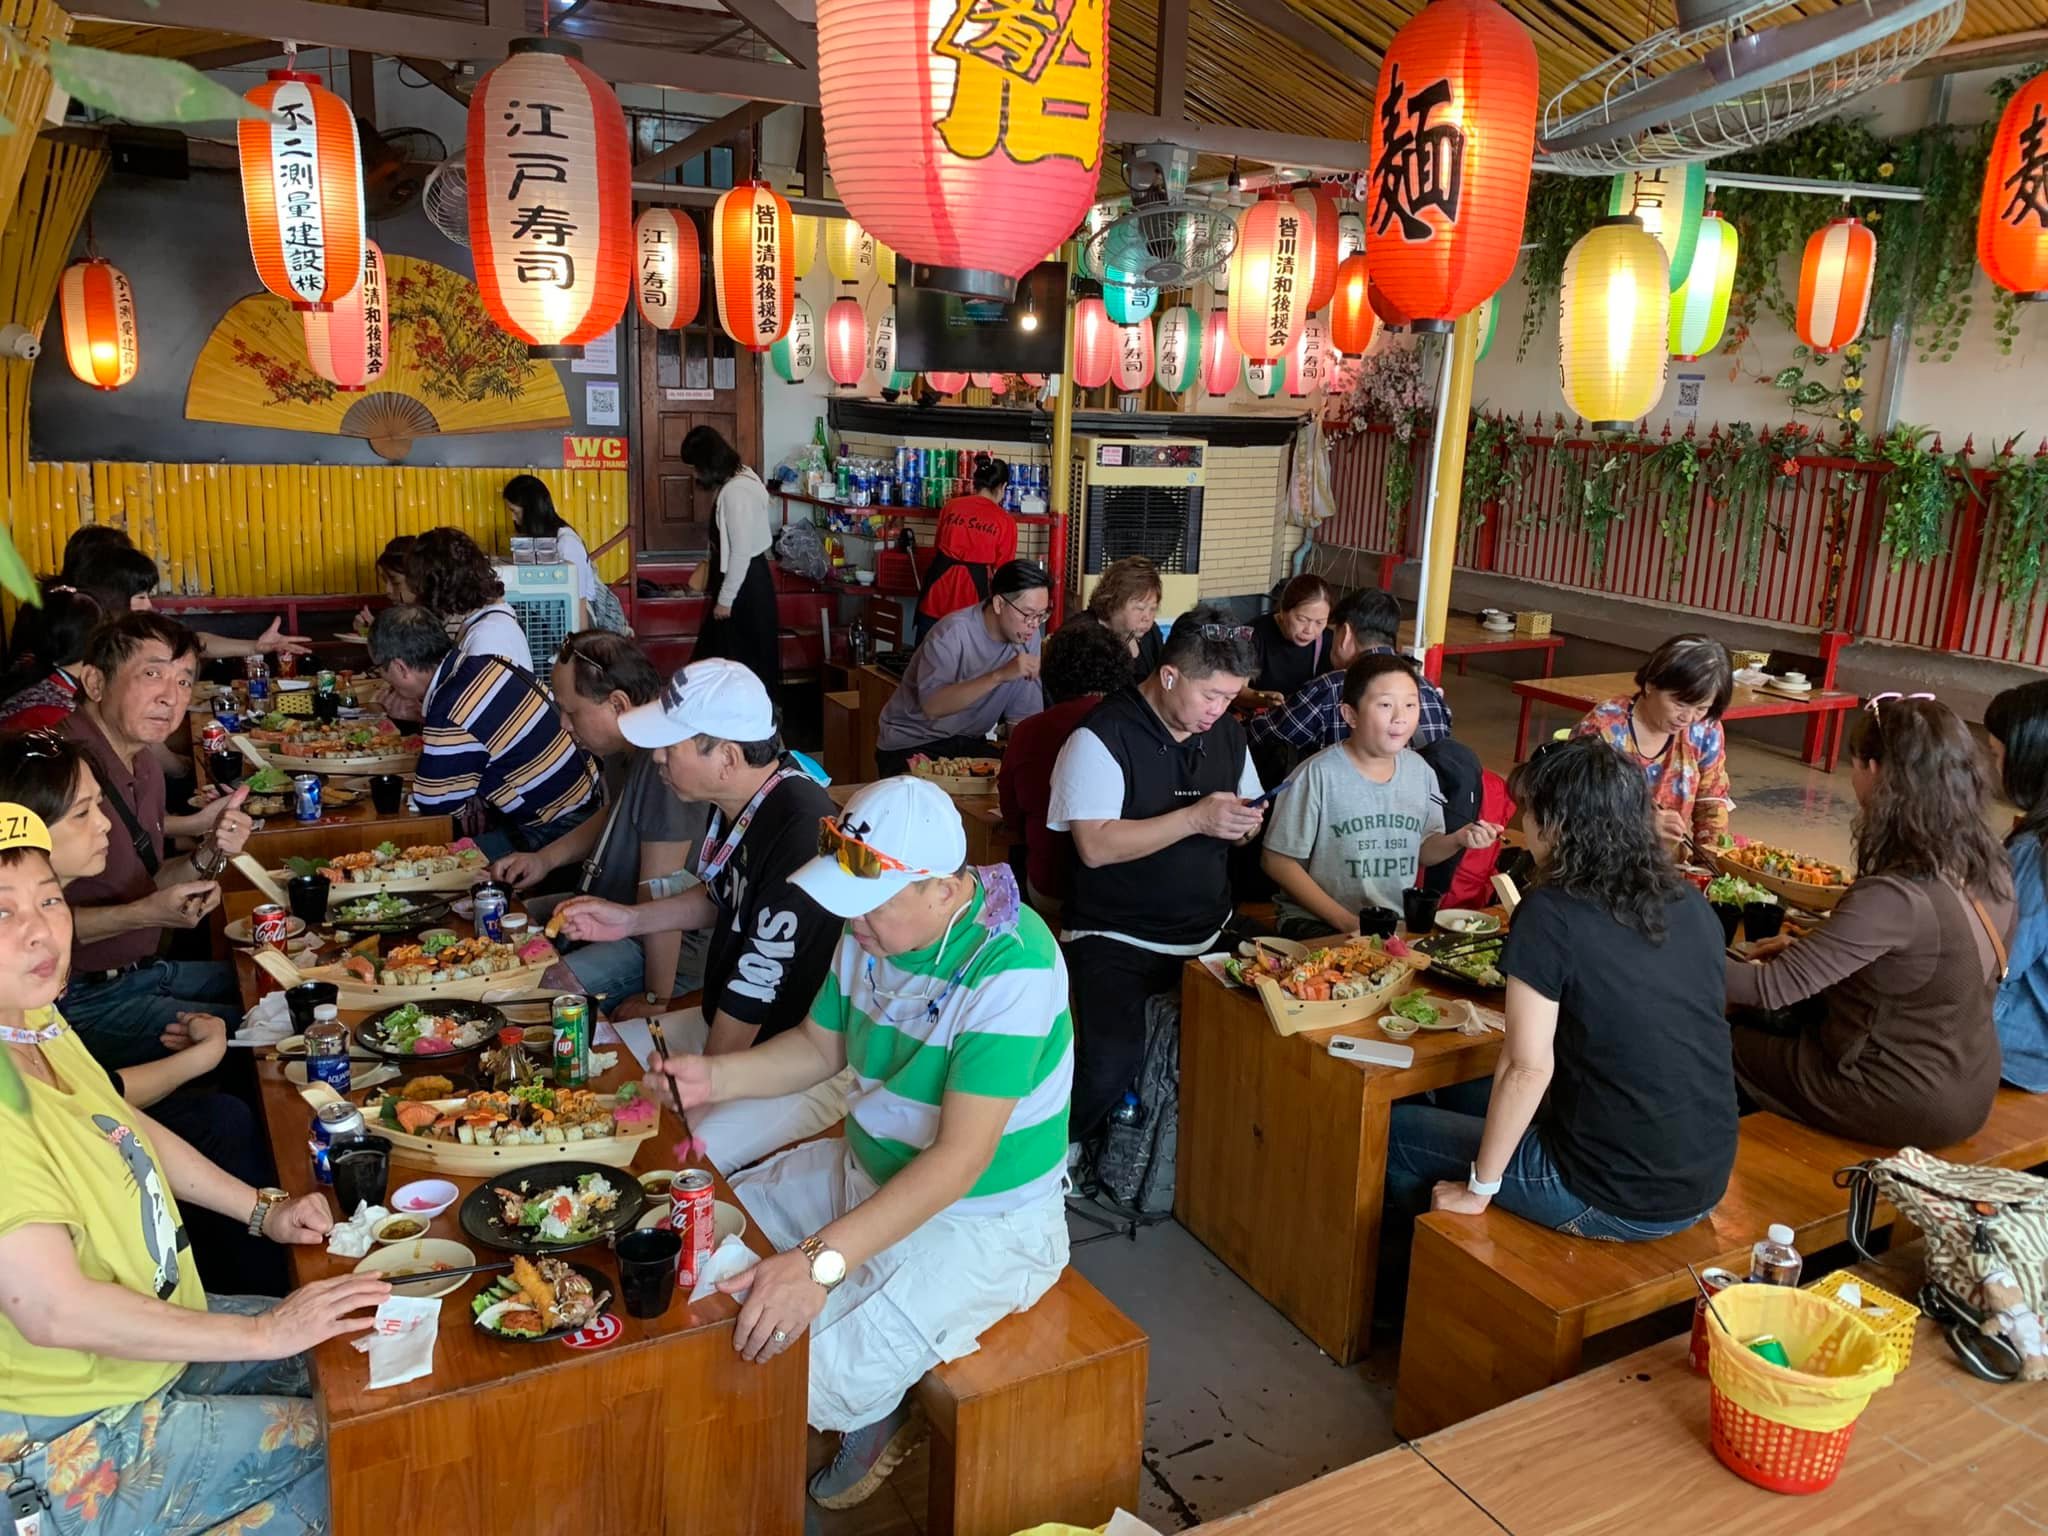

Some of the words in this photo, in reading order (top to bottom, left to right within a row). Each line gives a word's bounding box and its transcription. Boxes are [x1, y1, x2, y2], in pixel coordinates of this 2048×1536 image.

[277, 102, 325, 292] 不二測量建設株
[504, 100, 578, 290] 江戸寿司
[642, 228, 668, 307] 江戸寿司
[755, 204, 778, 334] 皆川清和後援会
[1269, 217, 1299, 347] 皆川清和後援会
[571, 437, 621, 458] WC
[1329, 813, 1422, 838] MORRISON
[1358, 839, 1381, 850] EST.
[1345, 856, 1415, 879] TAIPEI
